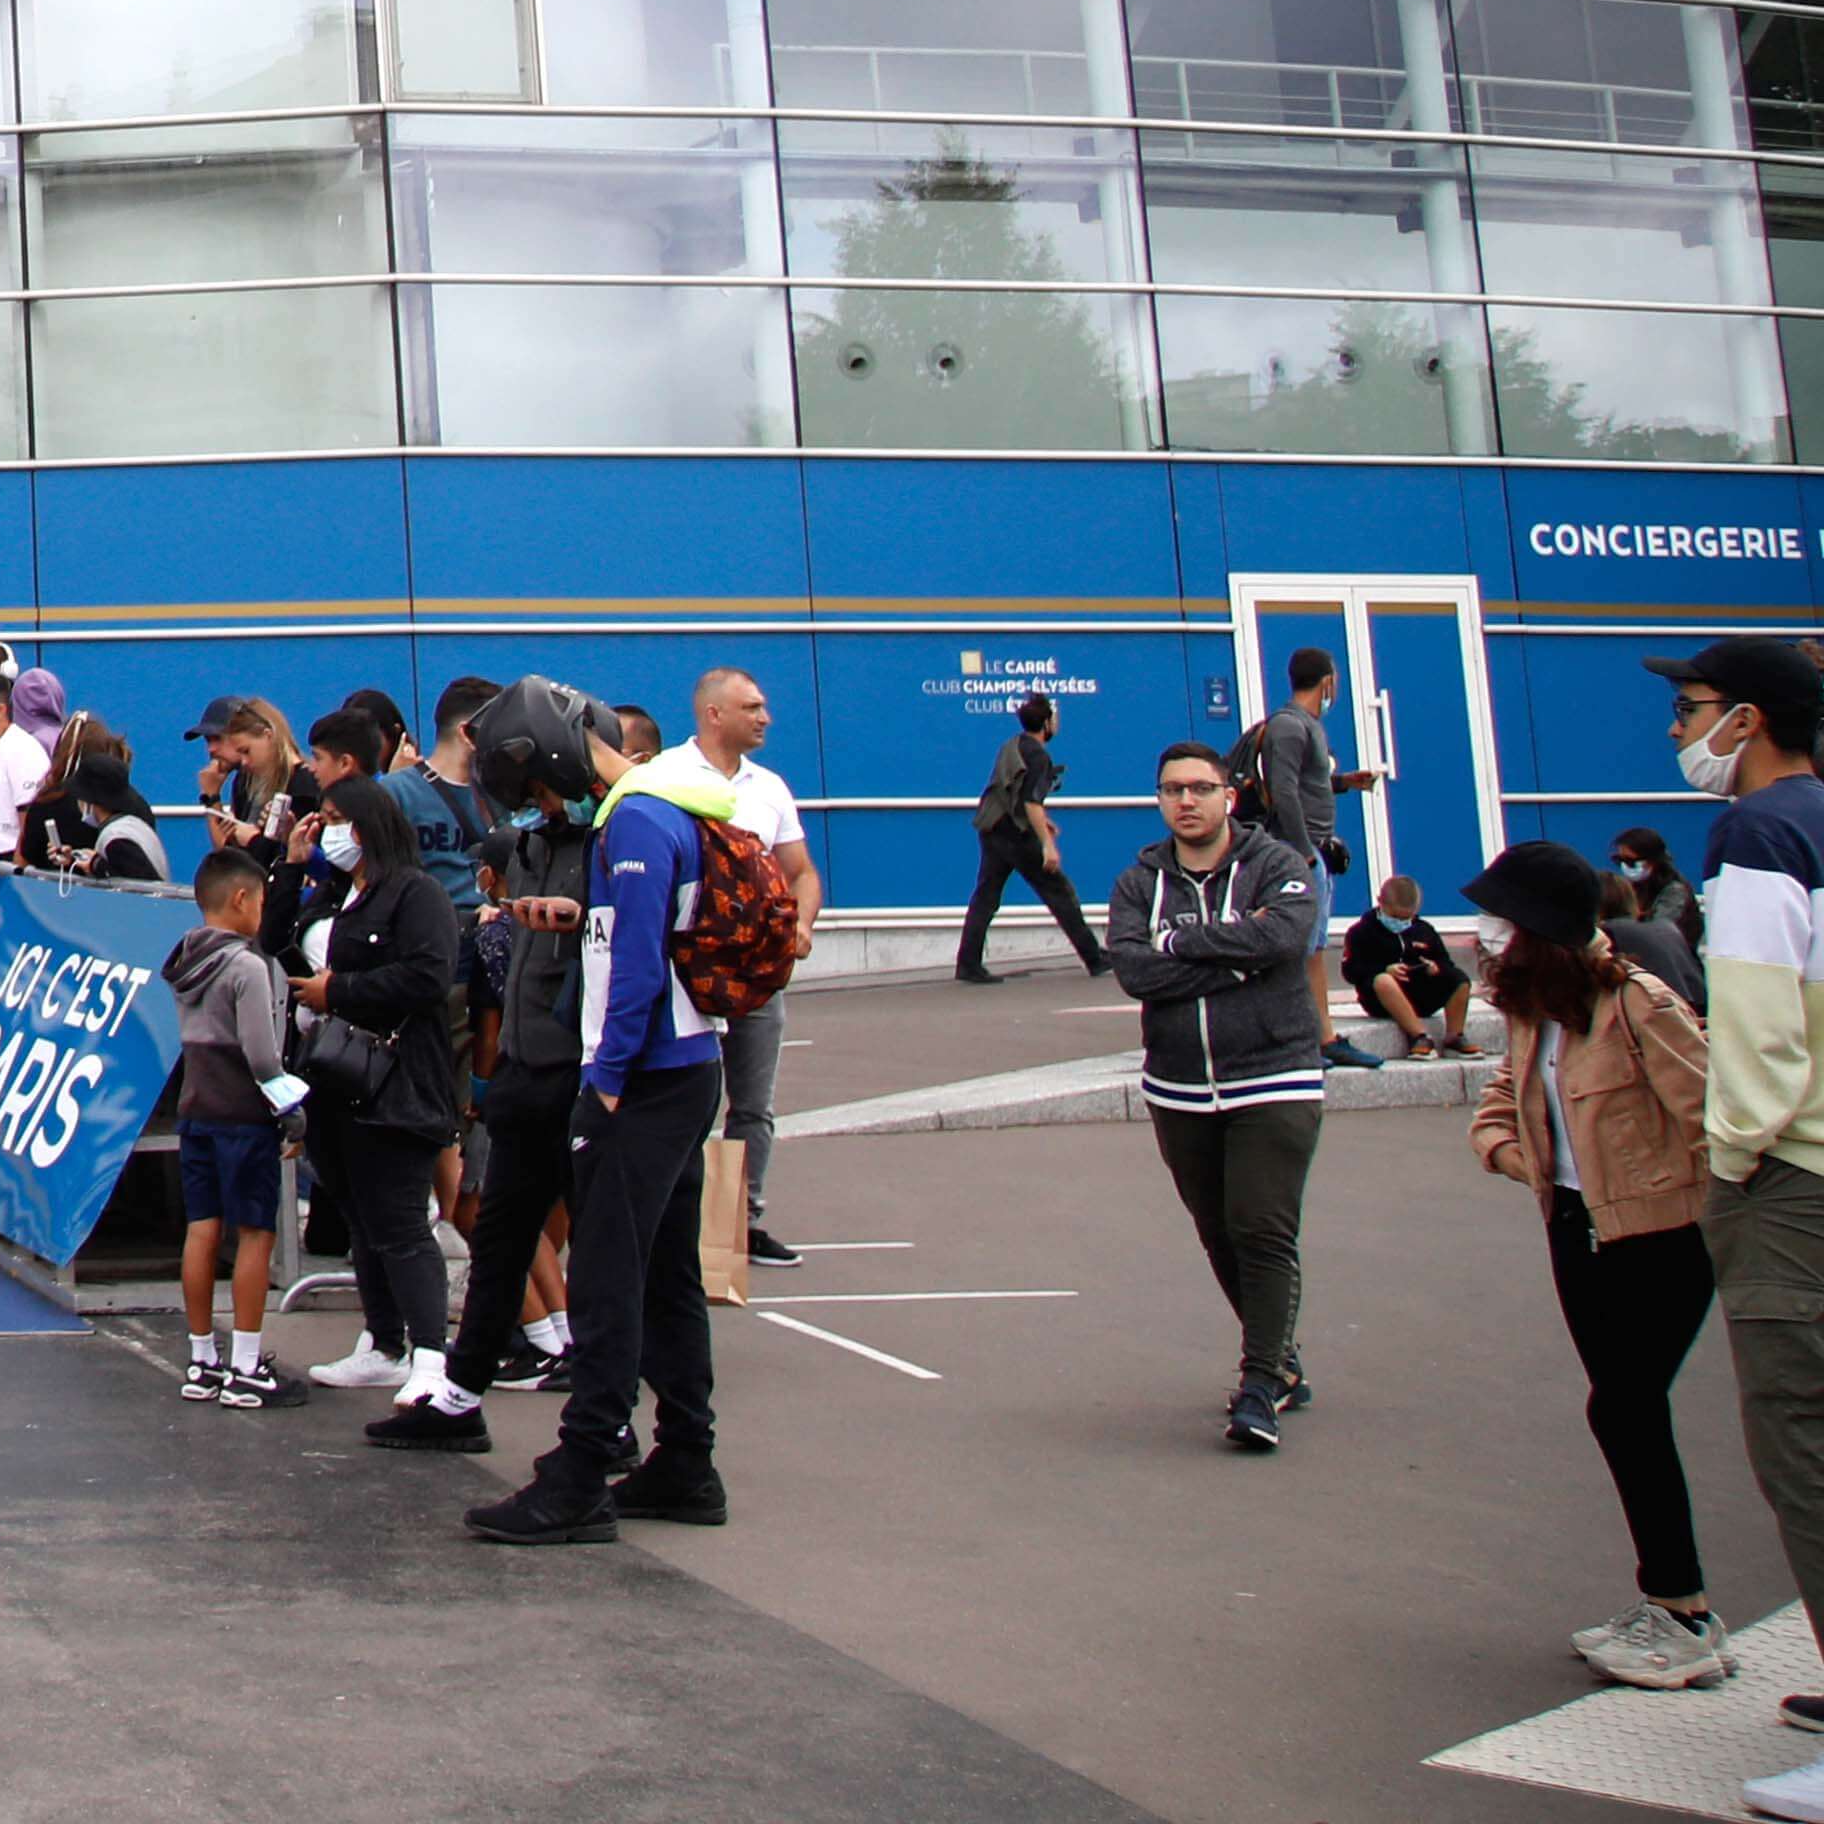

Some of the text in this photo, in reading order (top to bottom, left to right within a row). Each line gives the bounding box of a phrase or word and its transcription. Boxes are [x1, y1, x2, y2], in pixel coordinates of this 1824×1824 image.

[1529, 523, 1802, 559] CONCIERGERIE
[985, 656, 1057, 675] LE CARRÉ
[921, 679, 960, 694] CLUB
[964, 699, 1003, 714] CLUB
[41, 952, 153, 1038] C'EST
